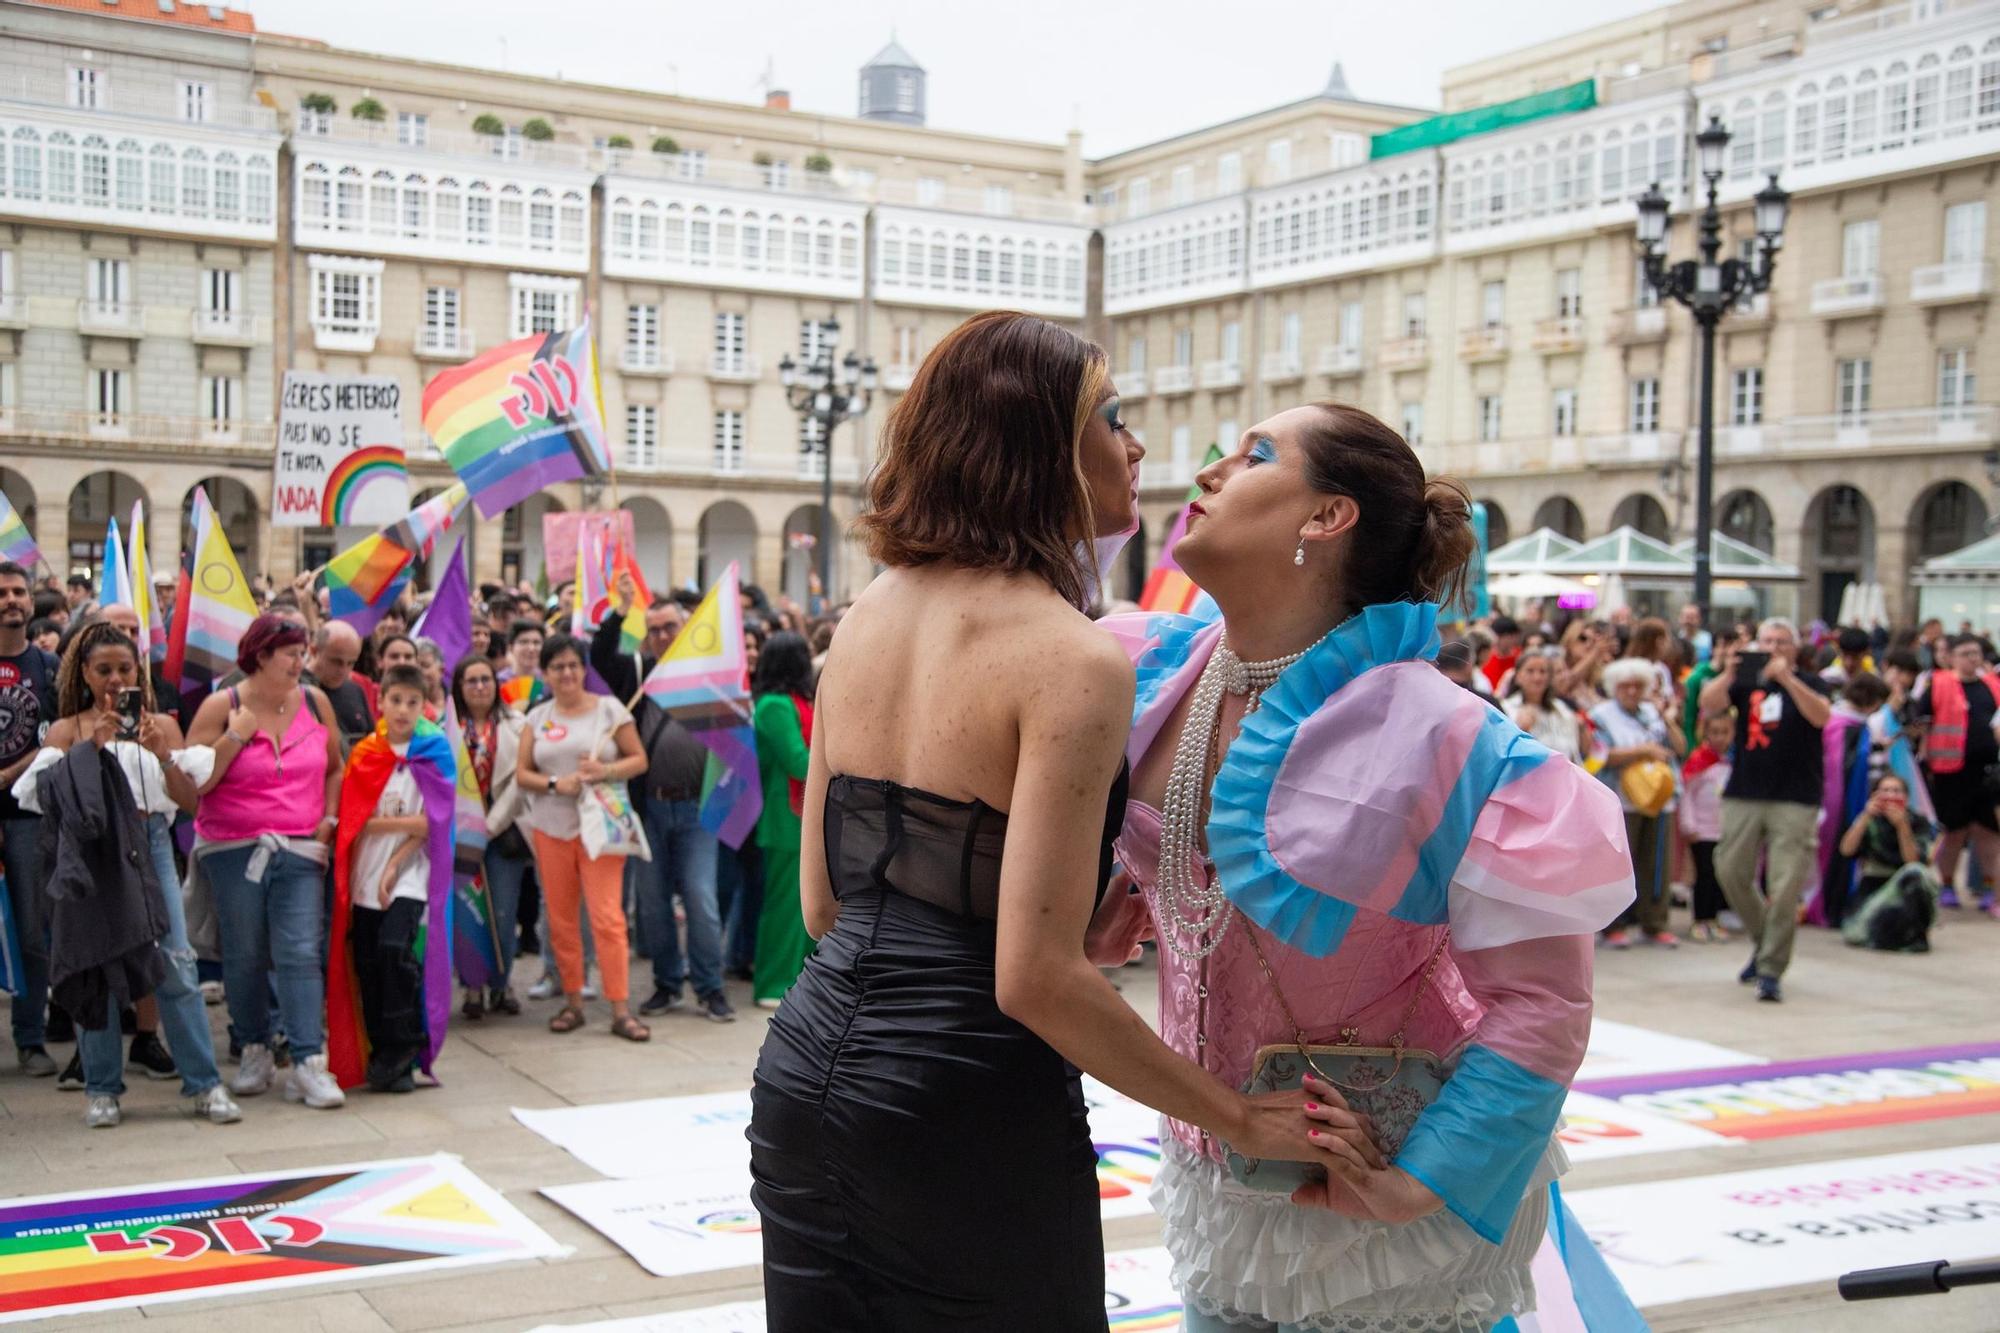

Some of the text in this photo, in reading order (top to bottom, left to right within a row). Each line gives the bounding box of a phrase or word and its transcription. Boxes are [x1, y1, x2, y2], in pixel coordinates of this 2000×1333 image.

[284, 378, 399, 418] ¿ERES HETERO?
[285, 422, 306, 443] PUES
[312, 425, 331, 445] NO
[282, 452, 325, 472] TE NOTA
[277, 486, 319, 513] NADA
[16, 1223, 88, 1237] Galega
[86, 1216, 327, 1261] CIG
